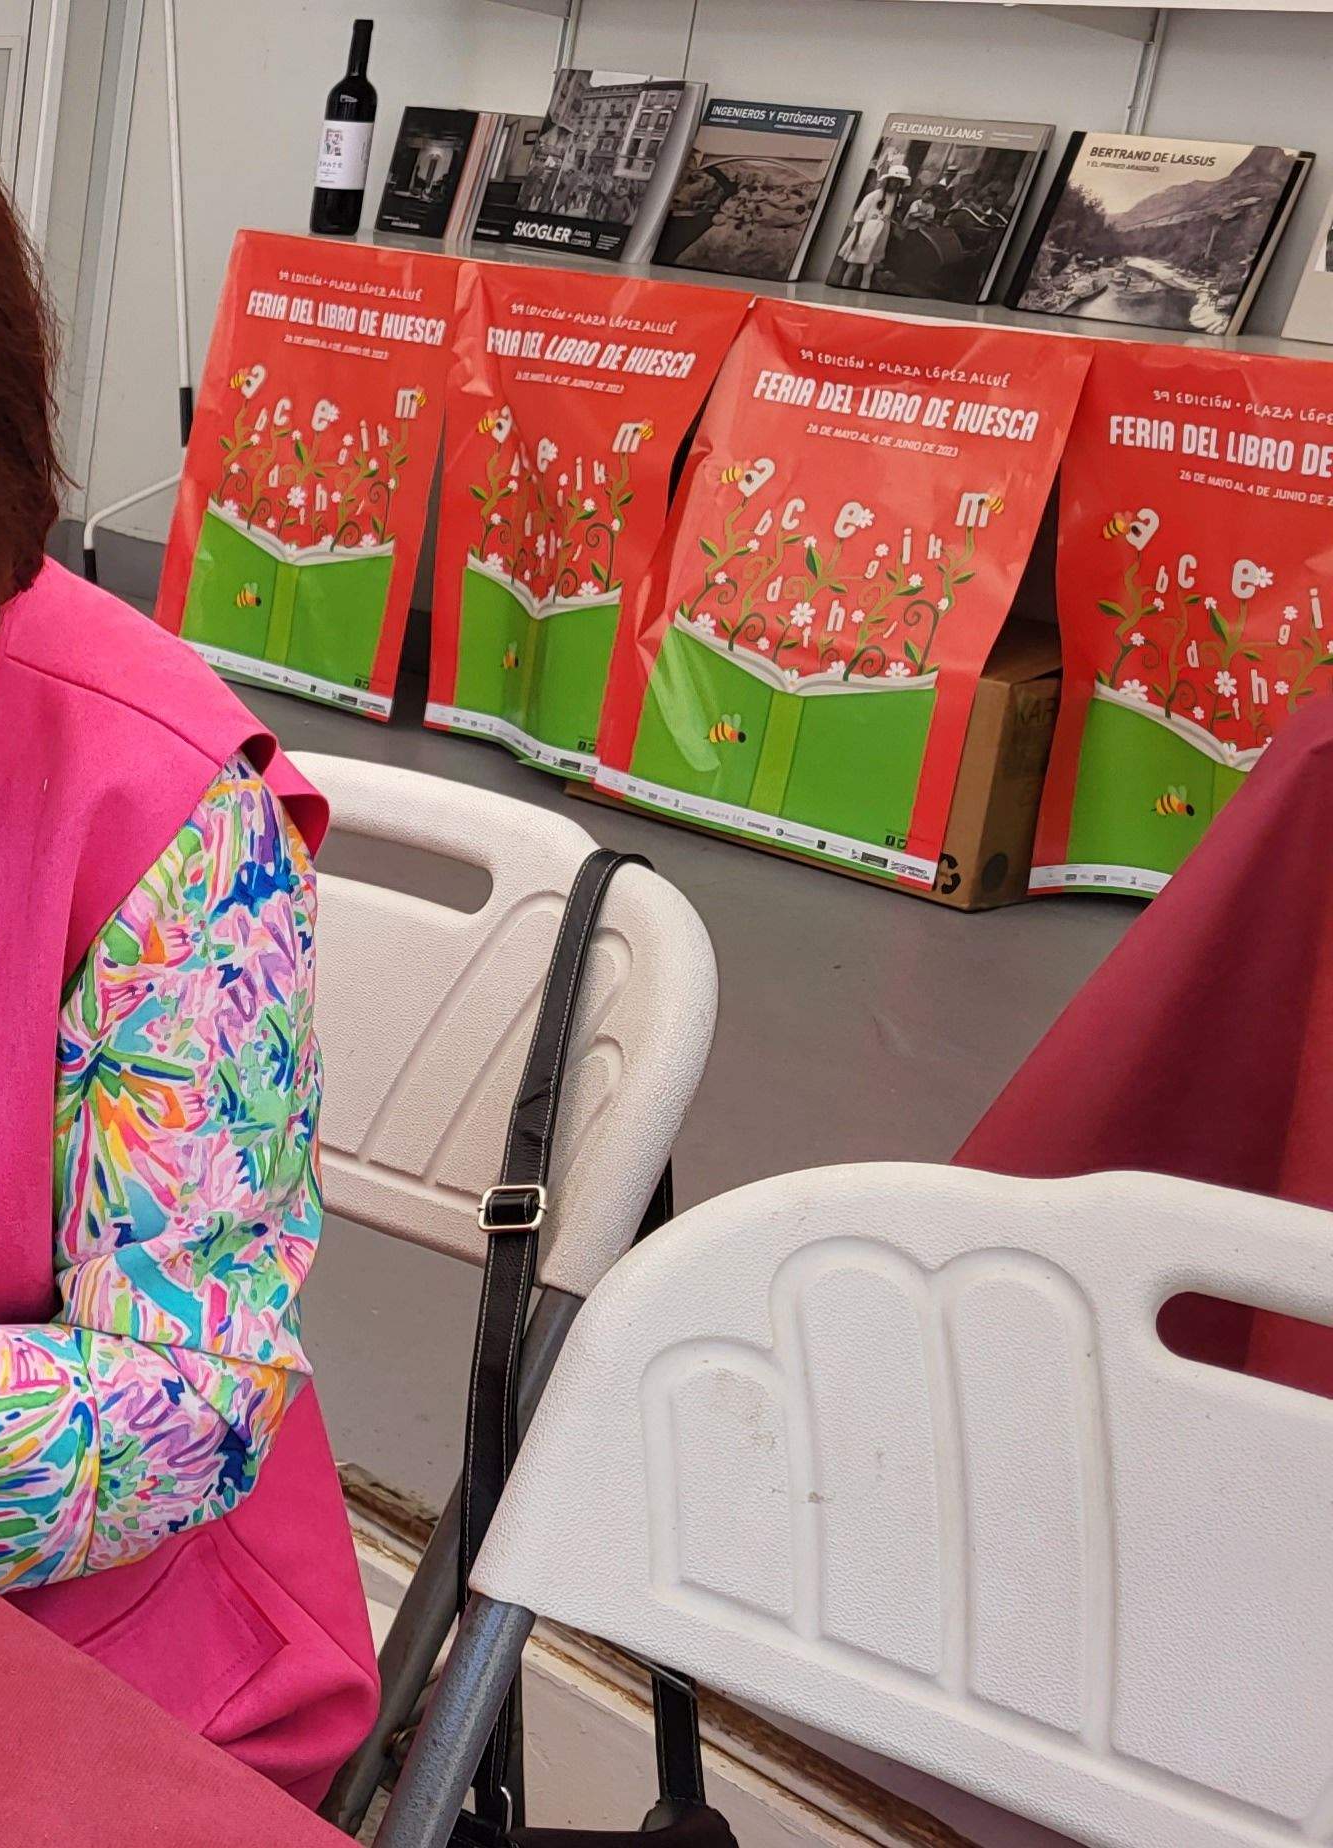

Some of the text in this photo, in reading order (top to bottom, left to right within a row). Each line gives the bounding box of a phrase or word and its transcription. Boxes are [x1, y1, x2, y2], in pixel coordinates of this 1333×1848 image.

[711, 105, 837, 127] INGENIEROS Y FOTÓGRAFOS
[890, 122, 943, 136] FELICIANO
[943, 126, 984, 140] LLANAS
[1090, 147, 1216, 167] BERTRAND DE LASSUS
[513, 220, 573, 243] SKOGLER
[388, 288, 423, 302] ALLUÉ
[246, 290, 447, 346] FERIA DEL LIBRO DE HUESCA
[573, 313, 606, 327] PLAZA
[608, 314, 641, 331] LÓPEZ
[641, 320, 678, 335] ALLUÉ
[521, 330, 545, 359] DEL
[544, 334, 602, 367] LIBRO
[597, 343, 629, 371] DE
[622, 346, 697, 379] HUESCA
[799, 349, 1011, 389] 39 EDICIÓN PLAZA LÓPEZ ALLUÉ
[753, 370, 1040, 442] FERIA DEL LIBRO DE HUESCA
[1152, 389, 1333, 426] 39 EDICIÓN PLAZA LÓPE
[806, 423, 819, 434] 26
[819, 425, 834, 437] DE
[833, 427, 859, 441] MAYO
[859, 431, 871, 444] AL
[880, 435, 893, 446] DE
[892, 436, 922, 452] JUNIO
[921, 441, 937, 453] DE
[935, 443, 959, 458] 2023
[1109, 415, 1333, 479] FERIA DEL LIBRO DE
[1179, 470, 1192, 481] 26
[1193, 471, 1206, 484] DE
[1207, 474, 1234, 490] MAYO
[1233, 480, 1247, 493] AL
[1247, 484, 1254, 494] 4
[1255, 484, 1271, 497] DE
[1272, 487, 1307, 503] JUNIO
[1309, 492, 1325, 506] DE
